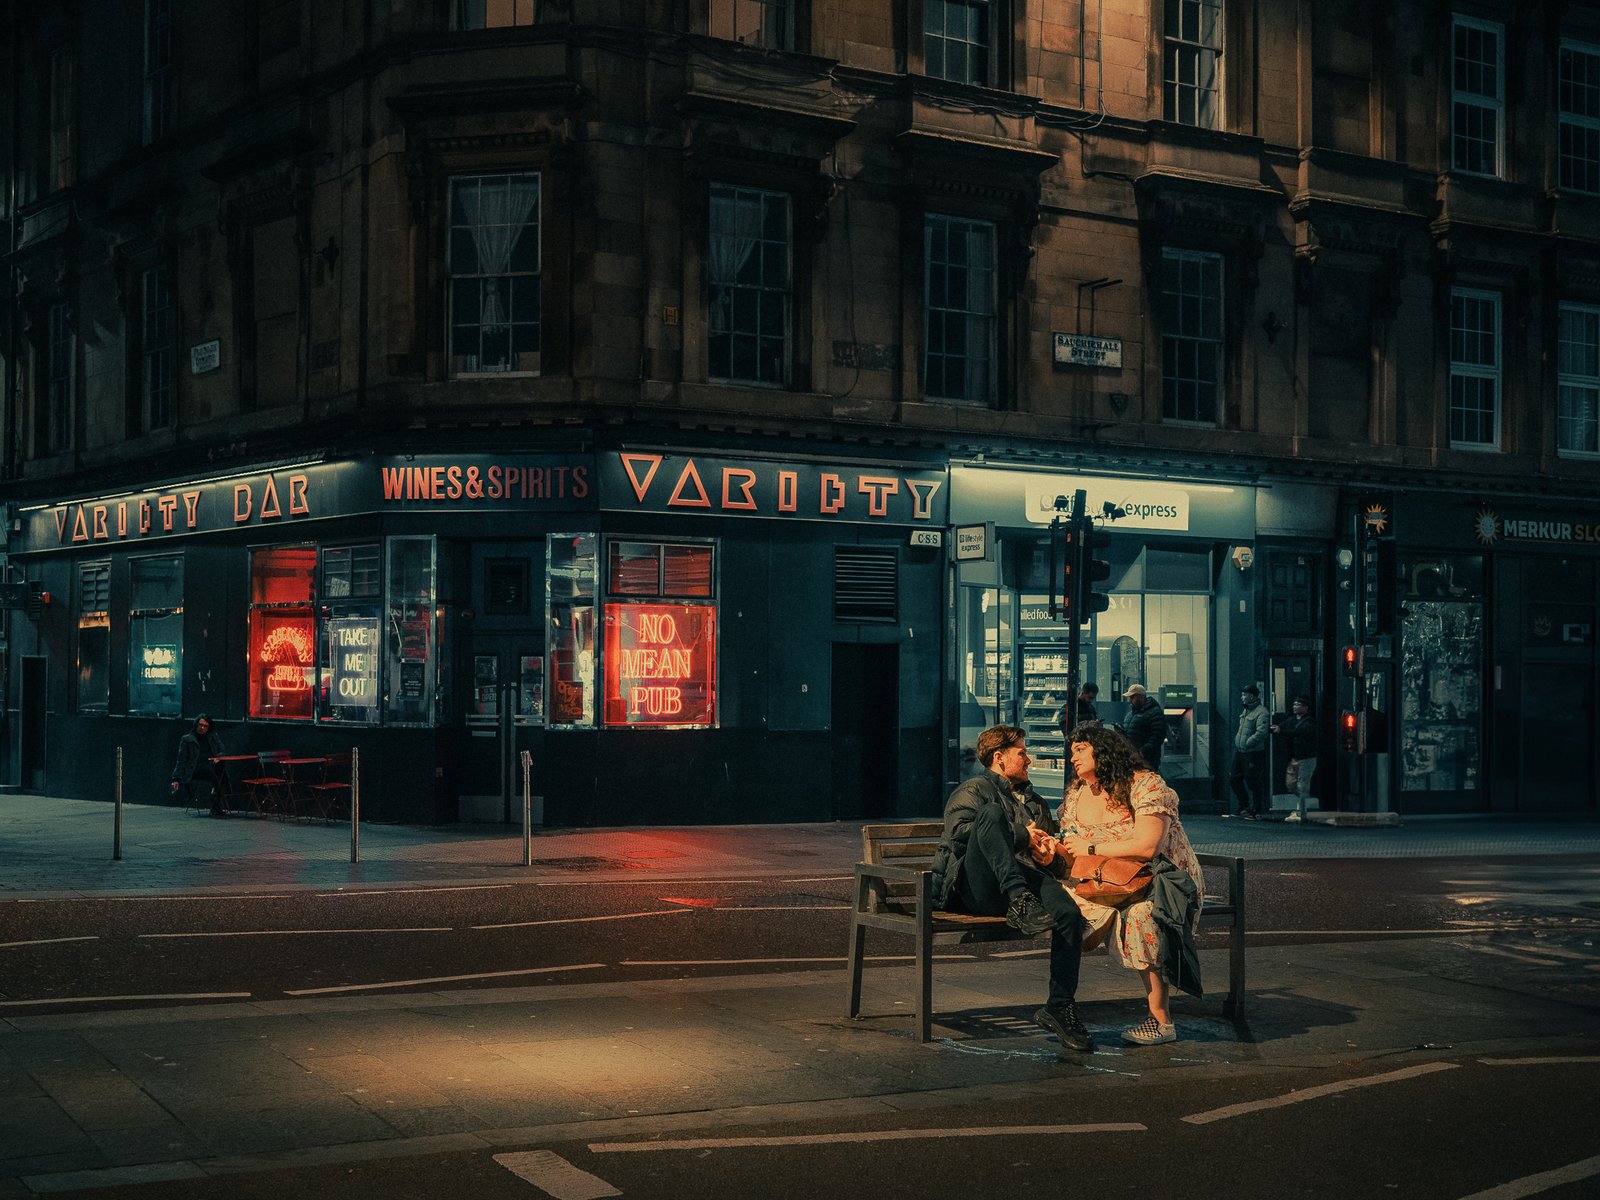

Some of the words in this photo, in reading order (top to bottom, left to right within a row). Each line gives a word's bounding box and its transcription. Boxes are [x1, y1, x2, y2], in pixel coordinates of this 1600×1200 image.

[1058, 335, 1119, 351] SAUCHIEHALL
[1072, 347, 1106, 361] STREET
[619, 452, 942, 519] VARIETY
[55, 491, 202, 544] VARIETY
[233, 474, 310, 523] BAR
[1126, 503, 1177, 519] express
[1503, 520, 1571, 540] MERKUR
[337, 627, 369, 647] TAKE
[639, 613, 676, 645] NO
[344, 653, 365, 672] ME
[622, 648, 692, 679] MEAN
[339, 677, 367, 696] OUT
[630, 685, 683, 715] PUB
